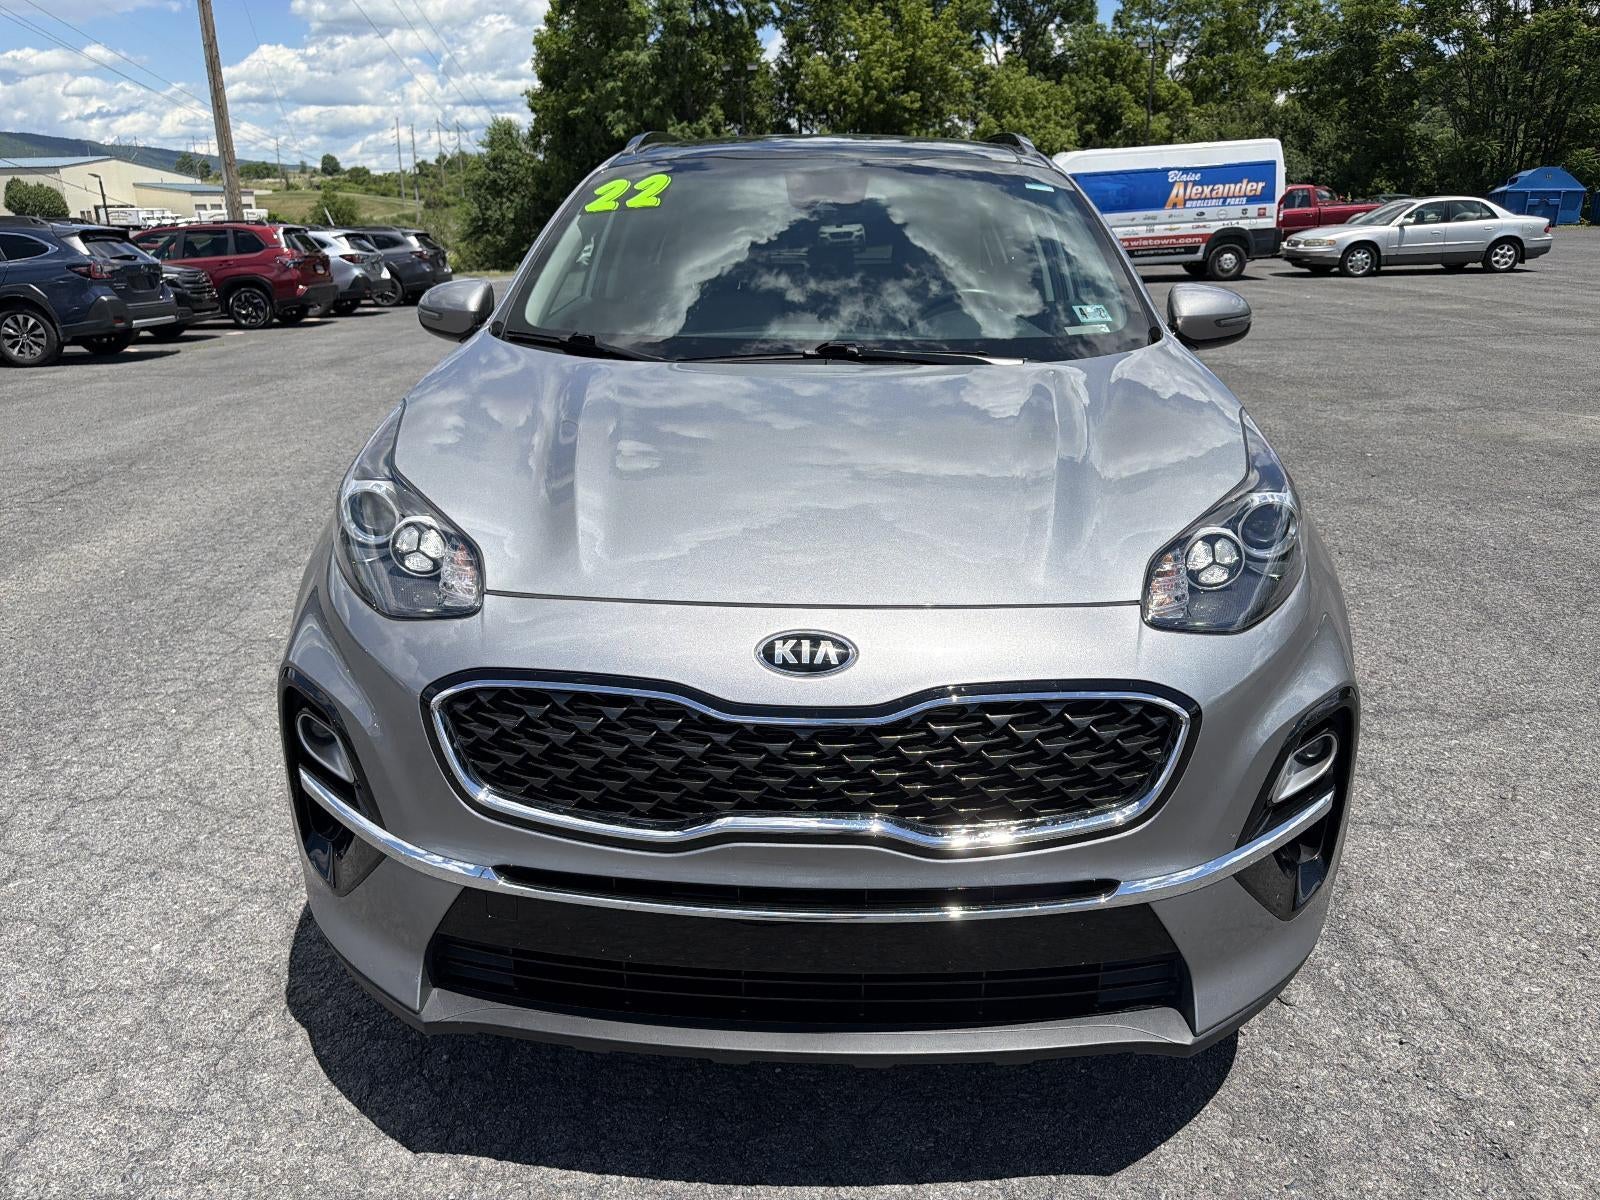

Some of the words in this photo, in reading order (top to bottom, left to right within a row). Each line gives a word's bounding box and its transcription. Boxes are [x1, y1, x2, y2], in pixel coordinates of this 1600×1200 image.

[1168, 170, 1202, 182] Blaise
[584, 174, 672, 212] 22
[1165, 178, 1266, 209] Alexander
[774, 639, 839, 665] KIA
